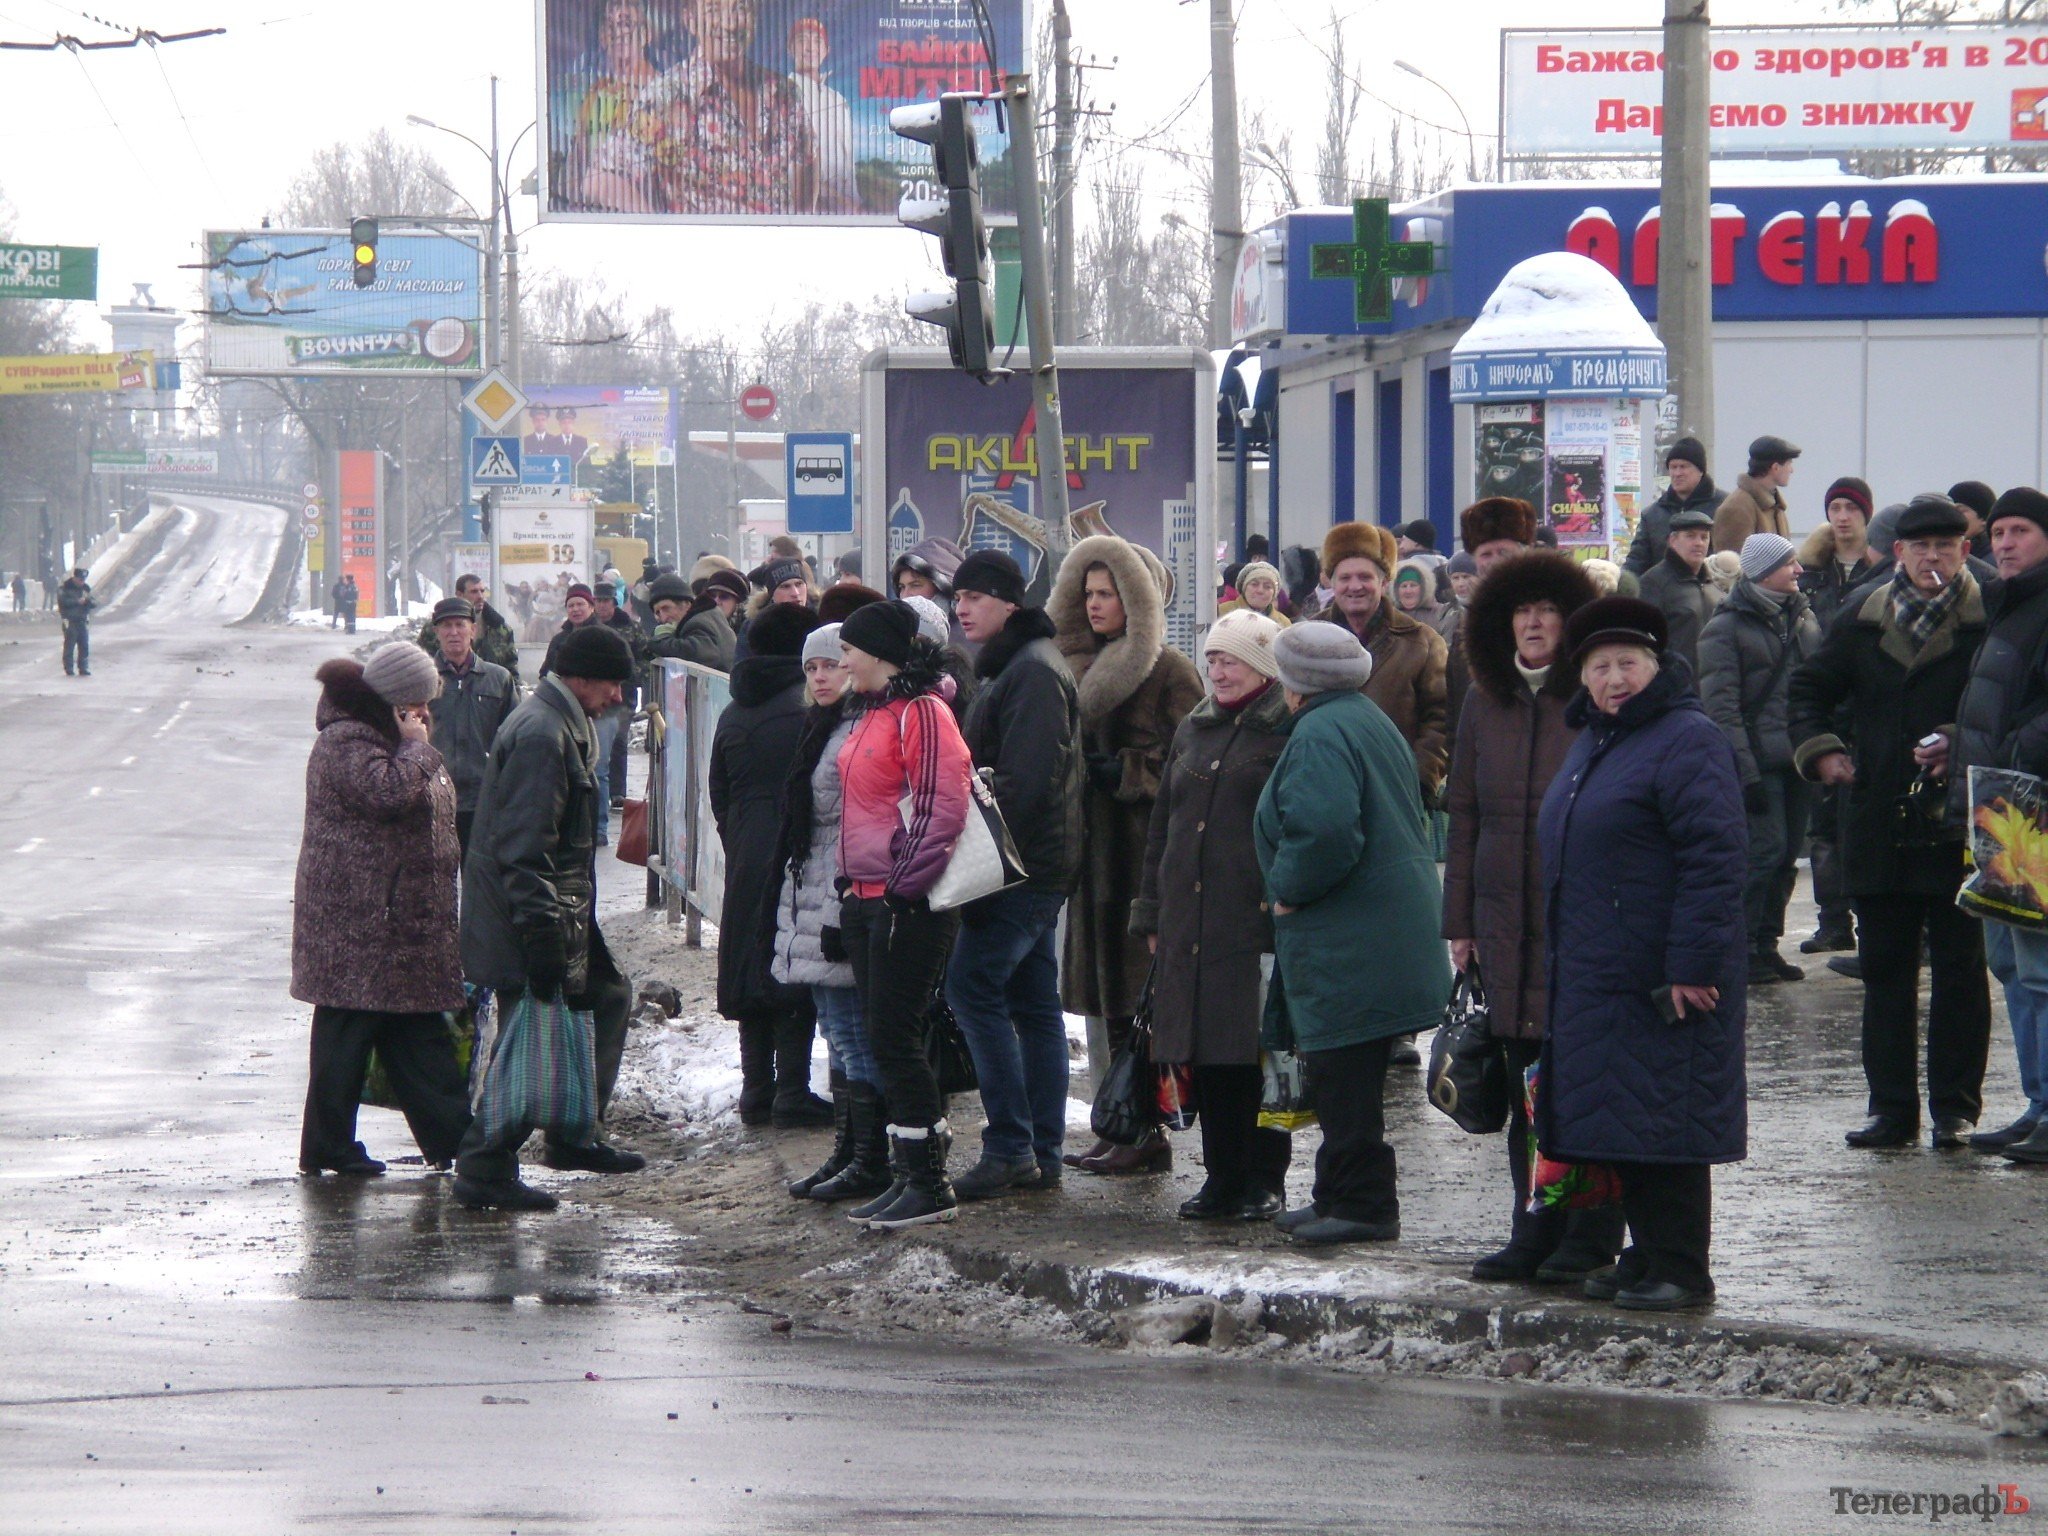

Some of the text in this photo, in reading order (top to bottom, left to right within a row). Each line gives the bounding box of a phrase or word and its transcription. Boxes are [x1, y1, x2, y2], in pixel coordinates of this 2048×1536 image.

[1536, 44, 1739, 74] Бажао
[1965, 46, 1989, 67] в
[1802, 101, 1974, 132] знижку
[384, 259, 412, 271] СВІТ
[396, 280, 464, 292] НАСОЛОДИ
[302, 334, 393, 354] BOUNTY
[1552, 502, 1600, 514] СИЛЬВА
[552, 544, 575, 564] 19
